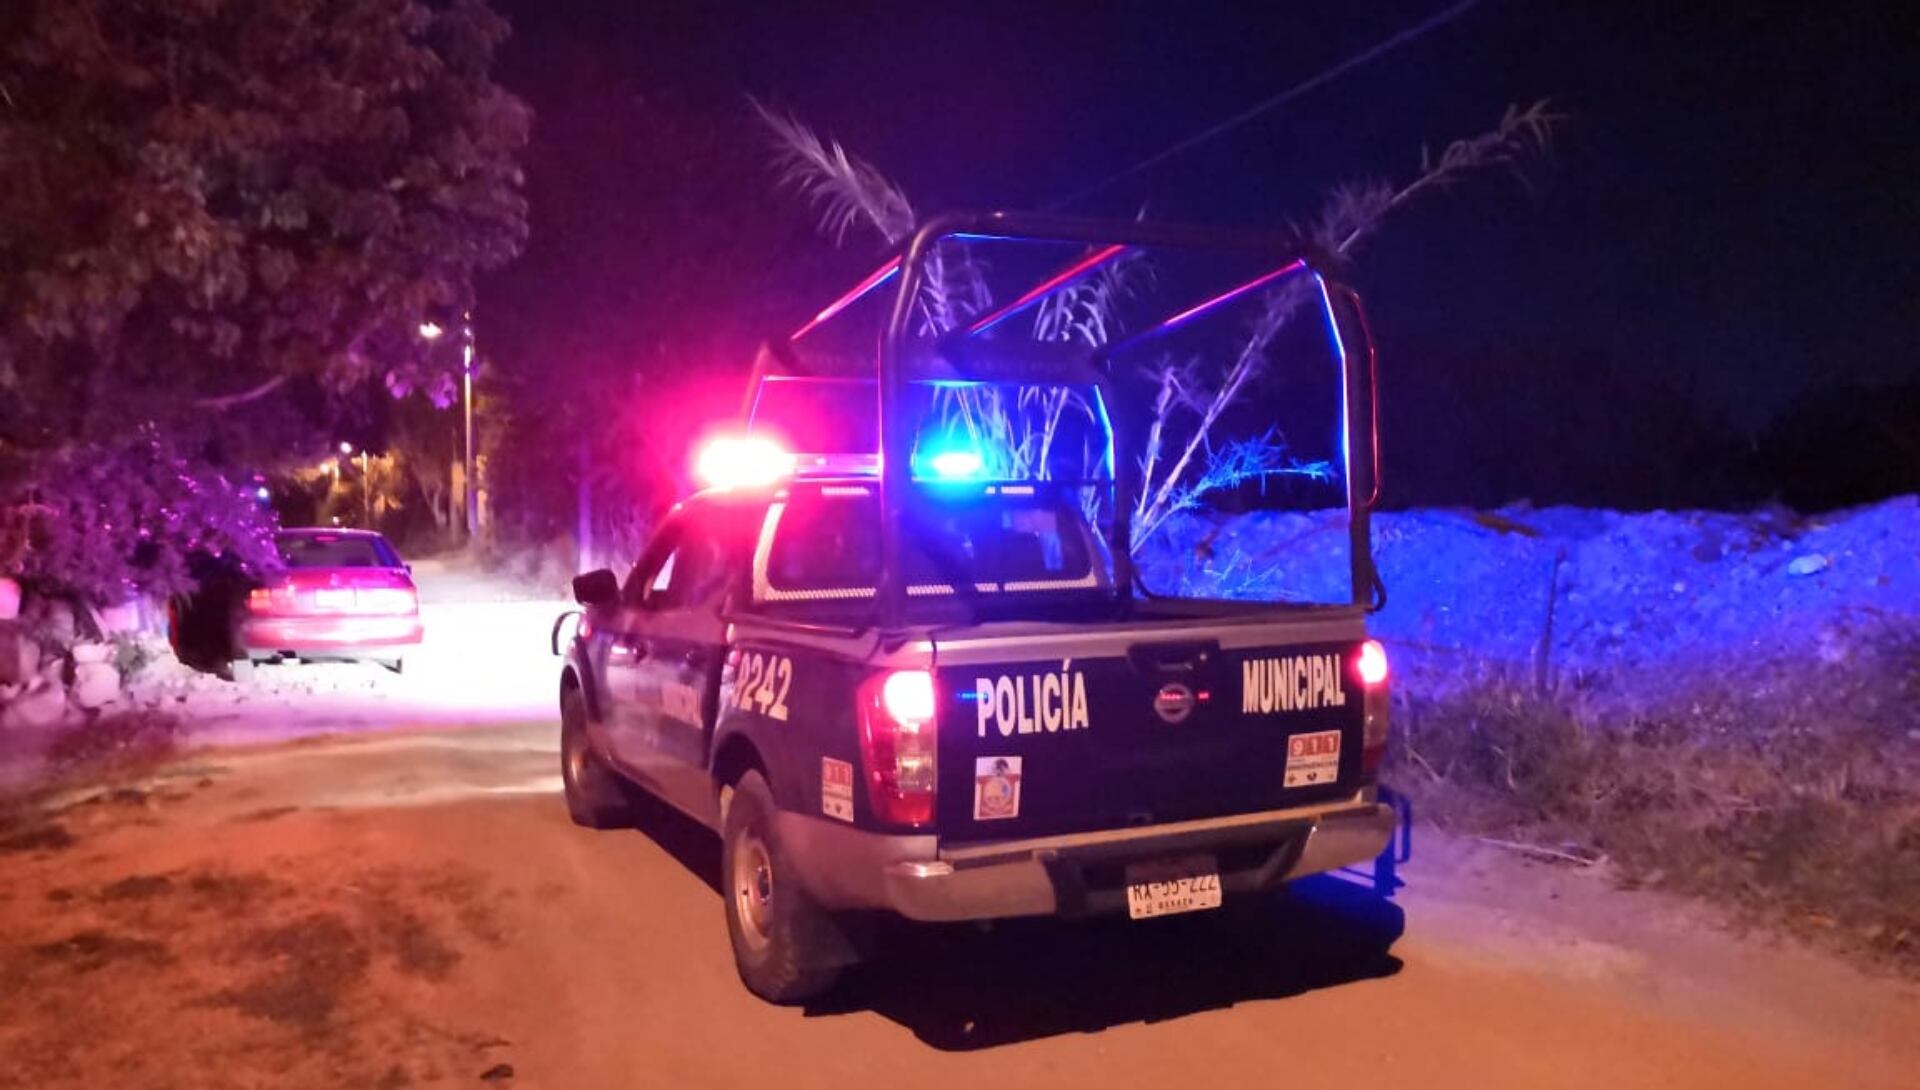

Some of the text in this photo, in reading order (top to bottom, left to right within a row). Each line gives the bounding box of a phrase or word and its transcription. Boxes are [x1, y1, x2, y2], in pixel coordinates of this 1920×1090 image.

[975, 653, 1346, 738] POLICÍA MUNICIPAL
[1292, 736, 1336, 756] 911
